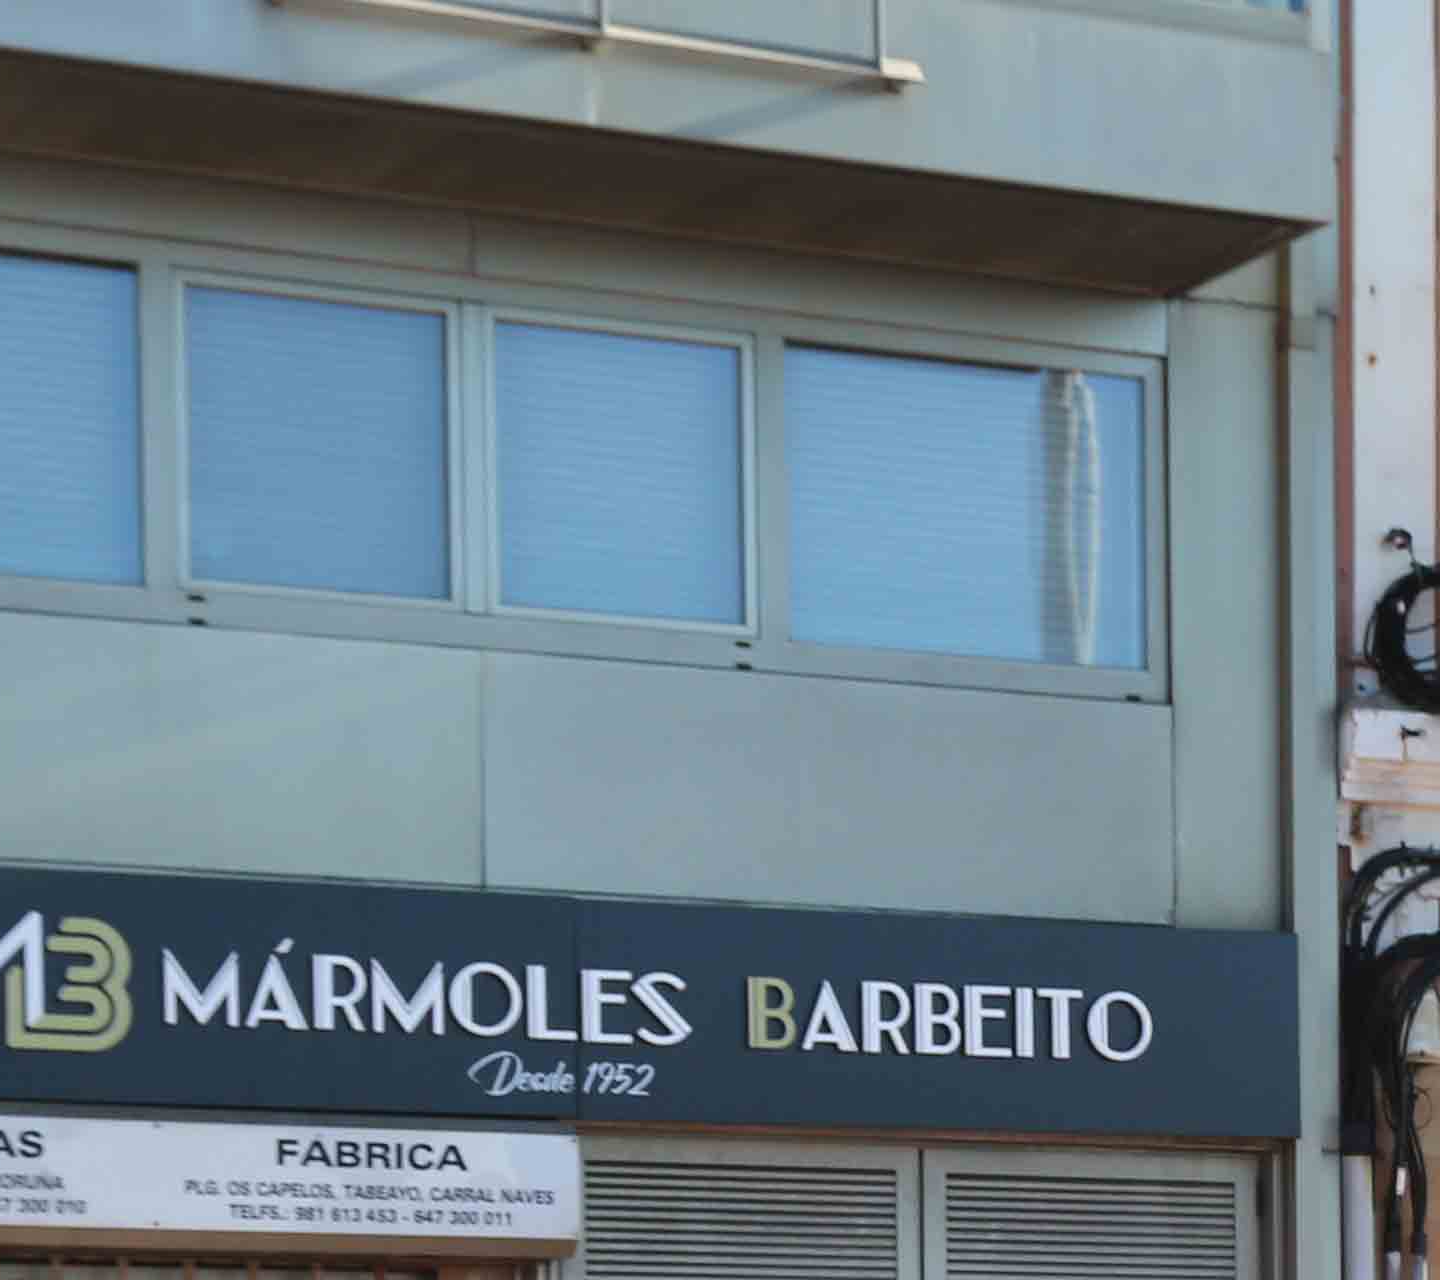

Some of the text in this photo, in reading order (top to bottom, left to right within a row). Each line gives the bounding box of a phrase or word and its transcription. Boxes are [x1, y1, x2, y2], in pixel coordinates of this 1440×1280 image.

[162, 937, 1153, 1063] MÁRMOLES BARBEITO
[467, 1050, 655, 1096] Desde 1952
[429, 1186, 496, 1204] CARRAL
[501, 1188, 556, 1206] NAVES
[295, 1206, 324, 1222] 981
[366, 1208, 399, 1224] 453
[413, 1209, 444, 1225] 647
[448, 1210, 480, 1226] 300
[484, 1211, 513, 1227] 011
